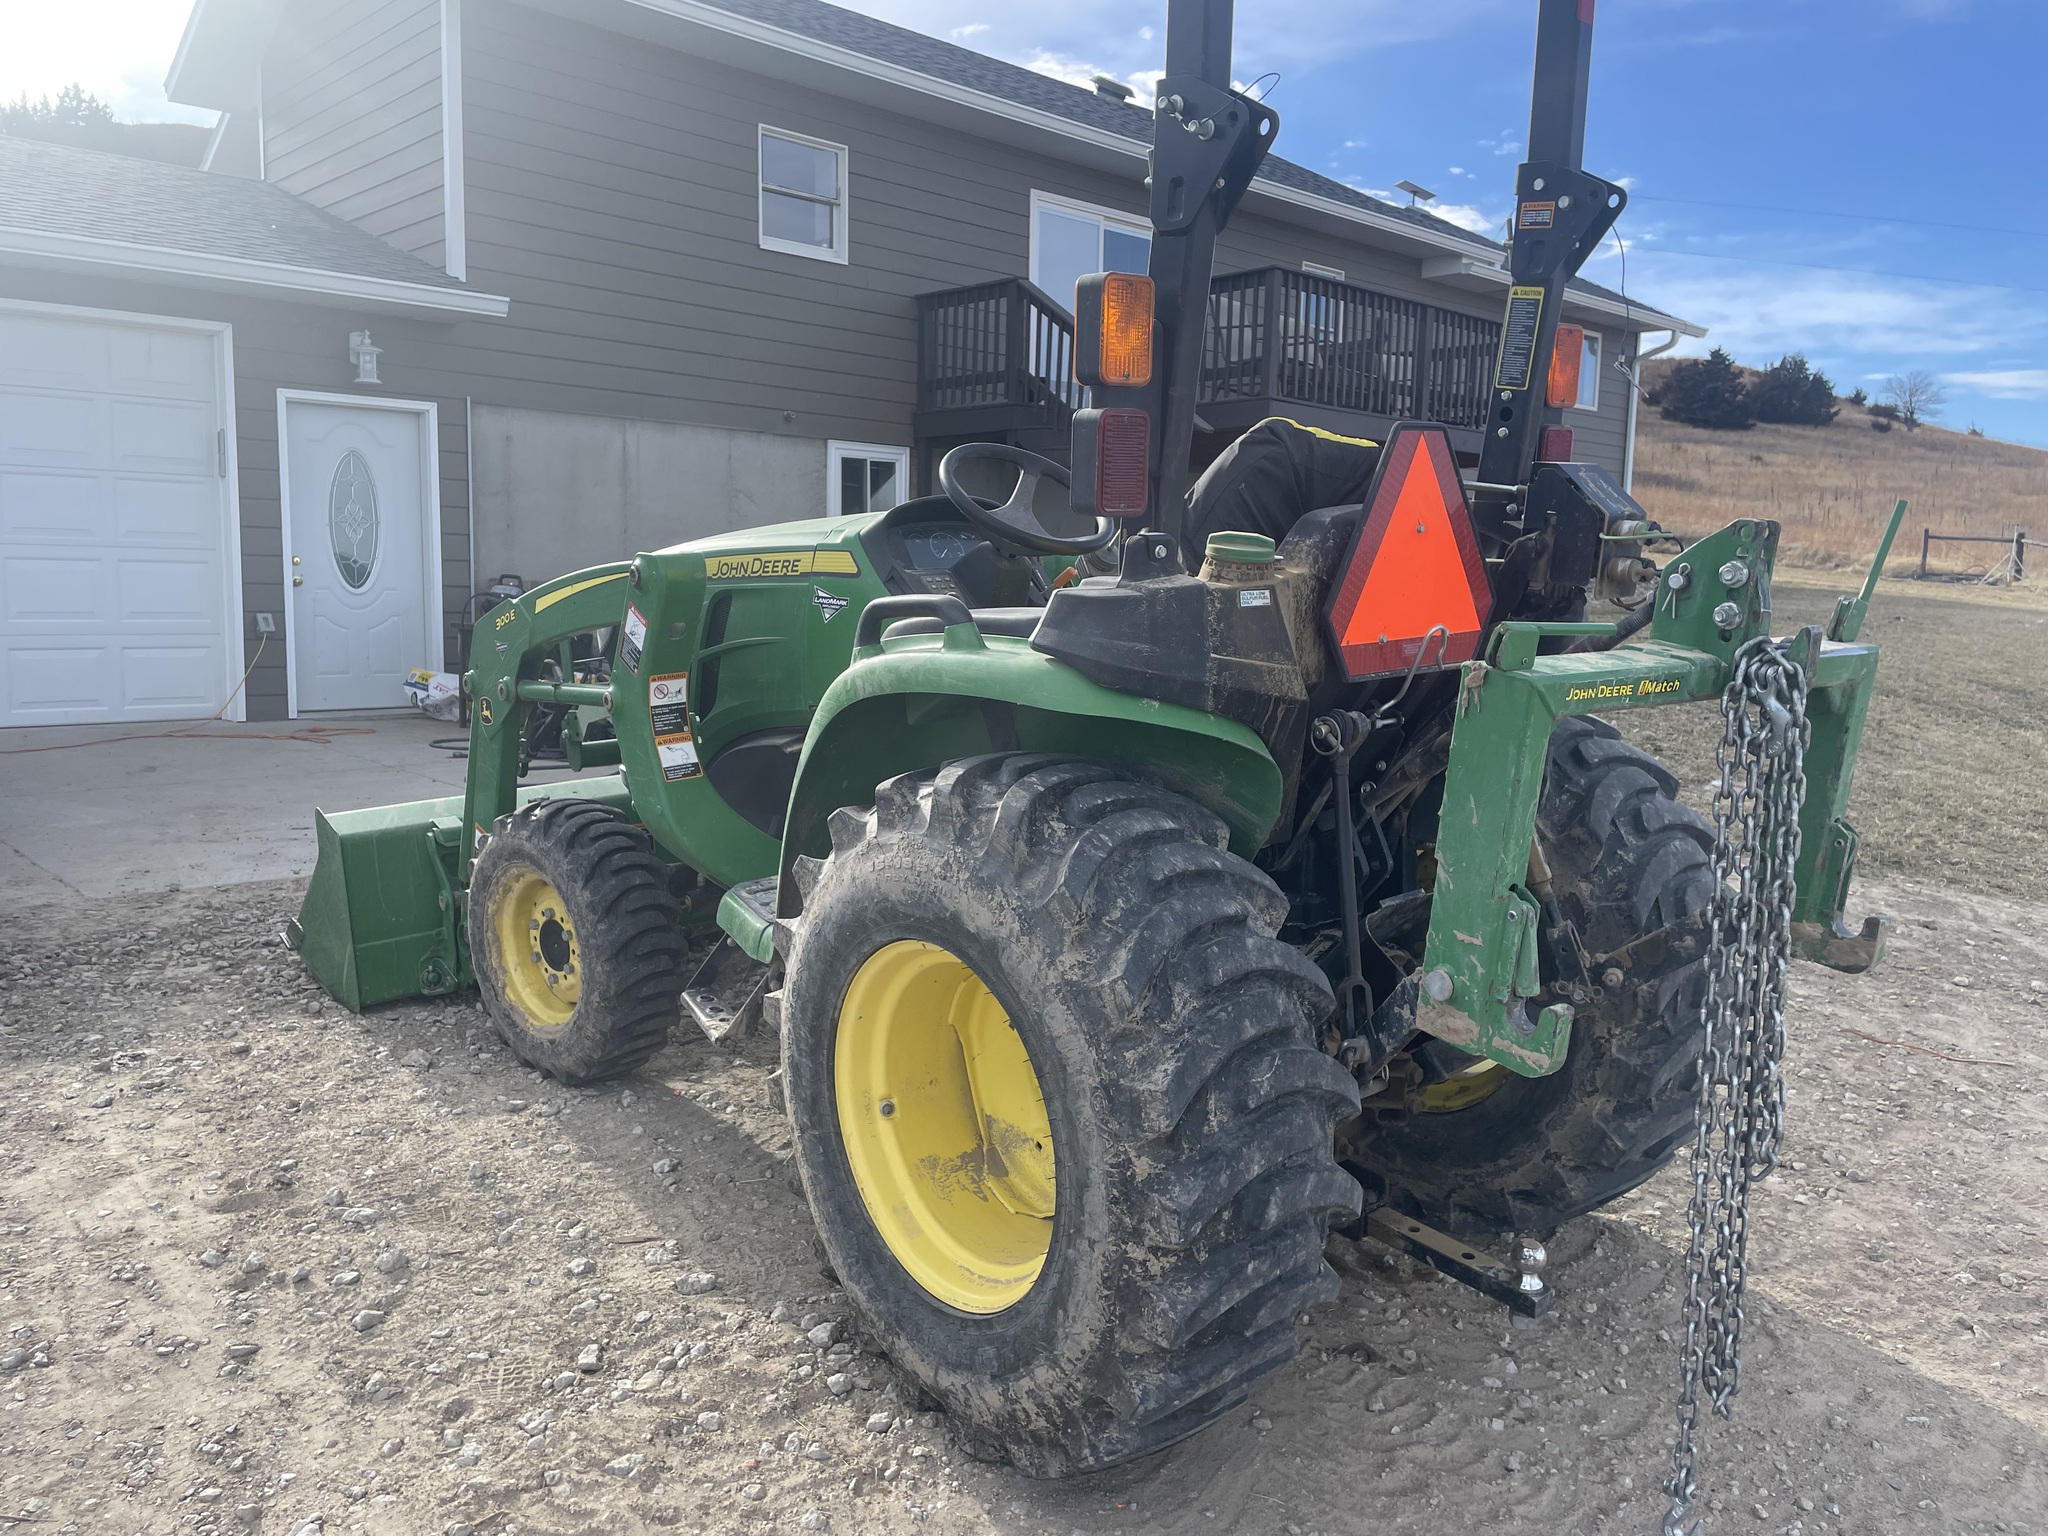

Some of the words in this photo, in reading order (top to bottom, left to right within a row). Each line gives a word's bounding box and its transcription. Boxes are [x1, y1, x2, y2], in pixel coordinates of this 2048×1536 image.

[1520, 289, 1542, 297] CAUTION
[712, 560, 749, 577] JOHN
[751, 558, 801, 576] DEERE
[495, 609, 516, 630] 300E
[656, 672, 686, 682] WARNING
[1565, 688, 1597, 701] JOHN
[1598, 684, 1634, 698] DEERE
[662, 735, 692, 745] WARNING
